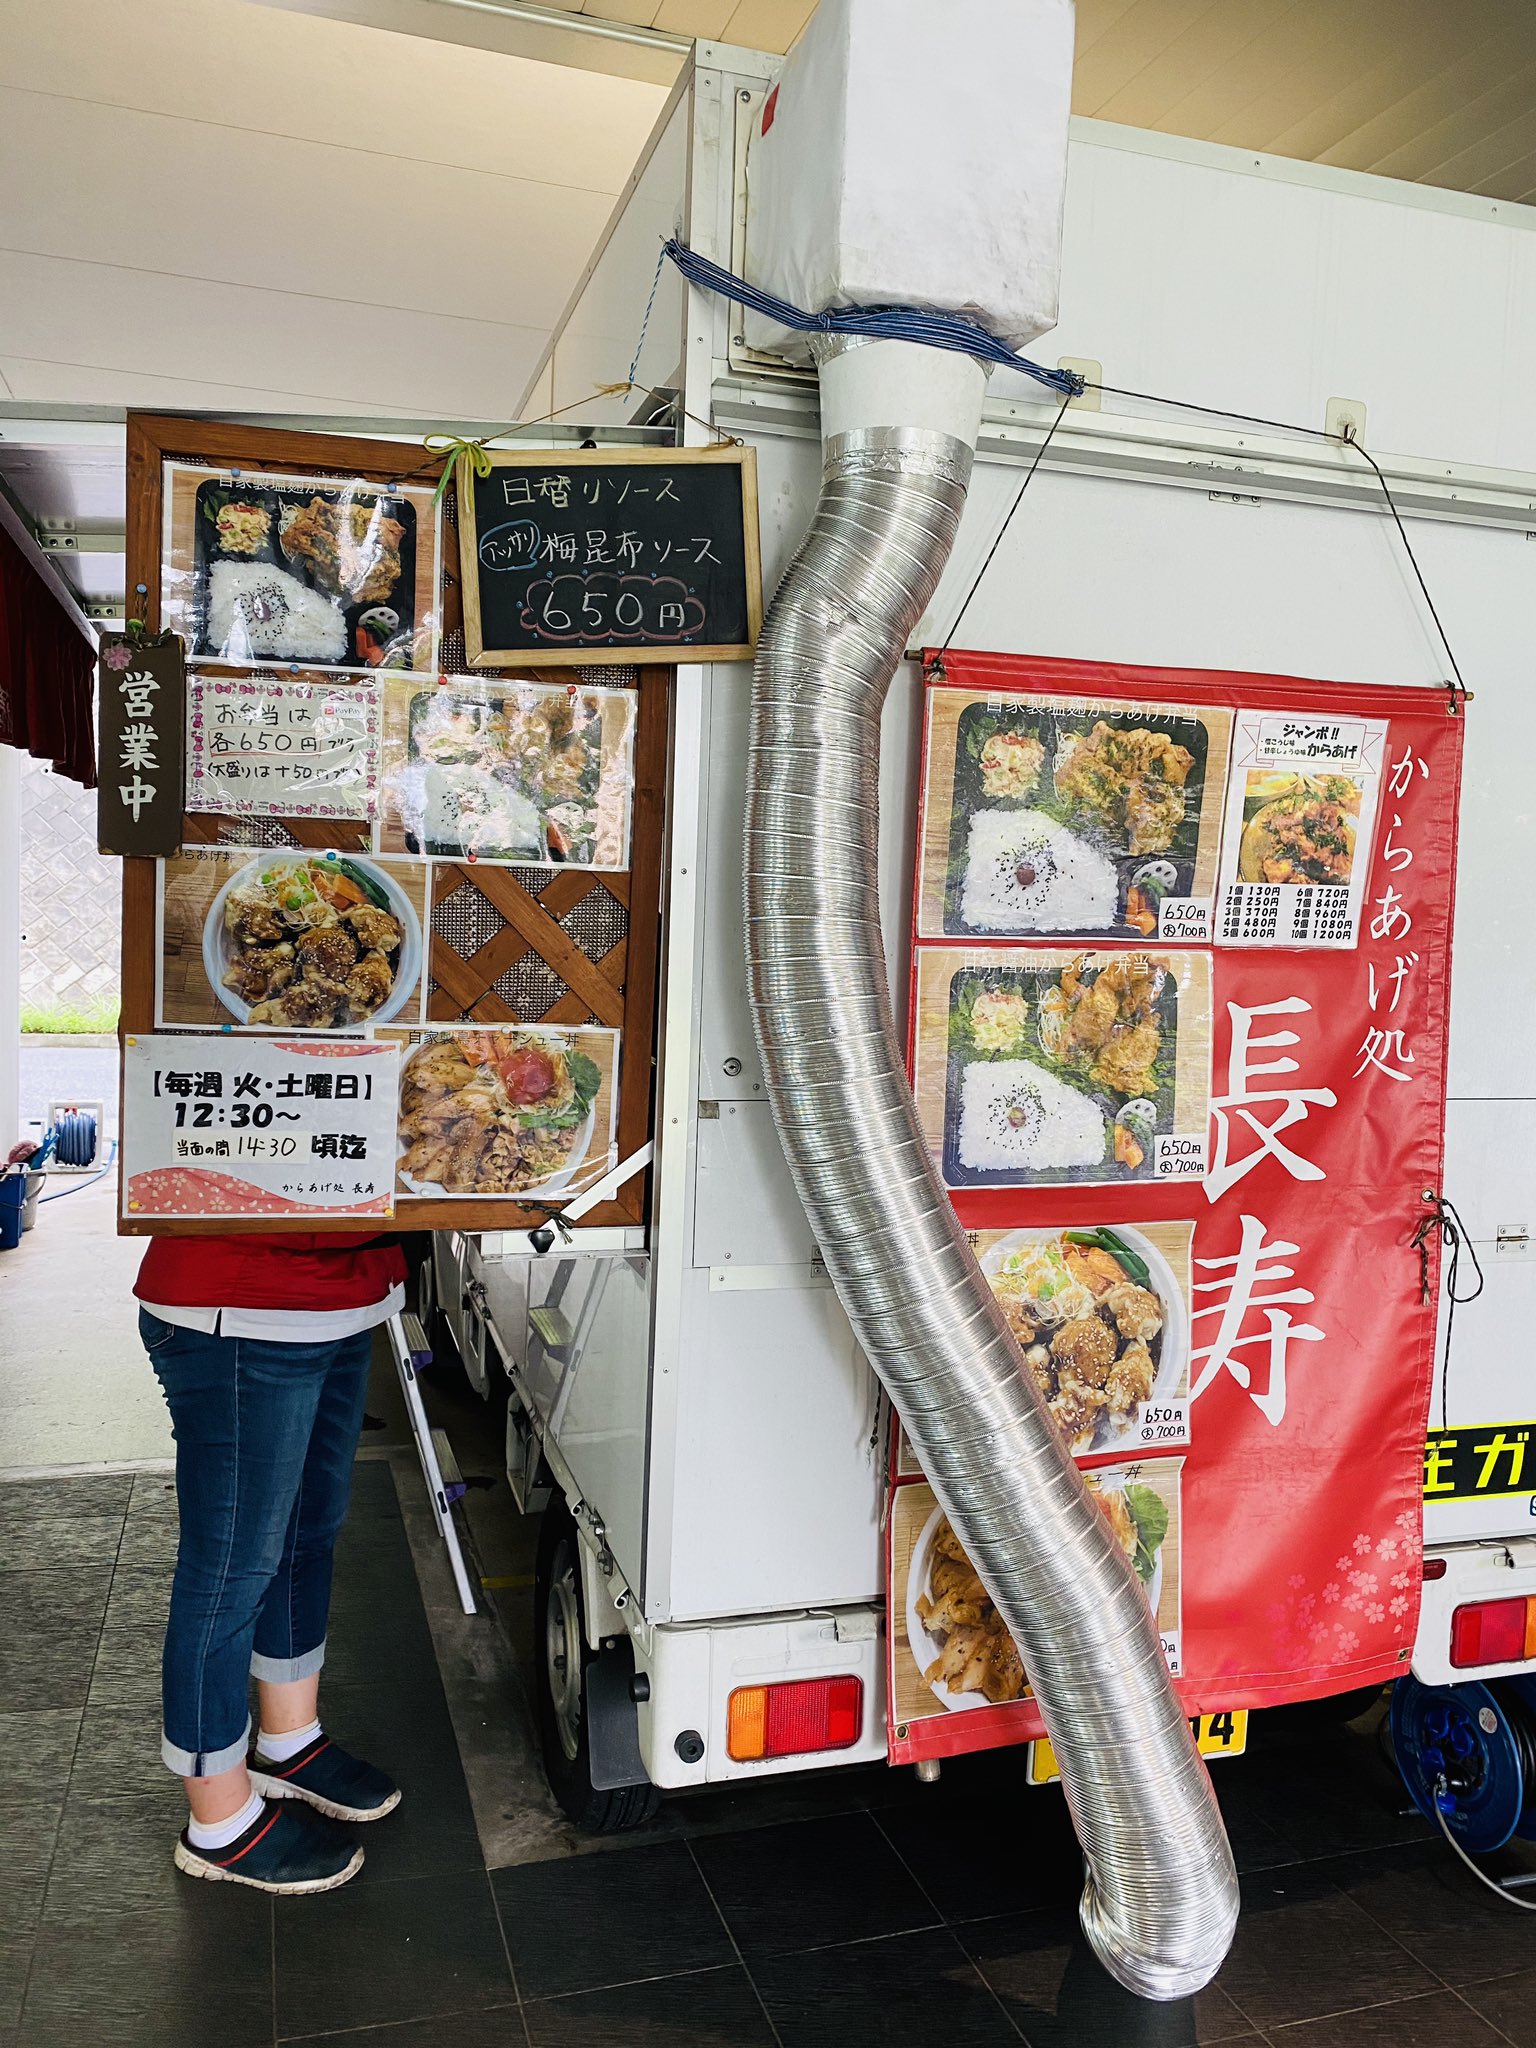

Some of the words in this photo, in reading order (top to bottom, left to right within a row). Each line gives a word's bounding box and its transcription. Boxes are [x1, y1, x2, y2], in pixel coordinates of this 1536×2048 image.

[540, 530, 722, 568] 梅昆布ソース
[543, 591, 685, 629] 650円
[118, 670, 161, 823] 営業中
[1307, 743, 1358, 759] からあげ
[179, 849, 234, 863] らあげ丼
[1249, 886, 1280, 896] 130円
[1317, 889, 1349, 898] 720円
[1246, 897, 1279, 906] 250円
[1316, 899, 1347, 908] 840円
[1164, 904, 1206, 919] 650円
[1245, 908, 1277, 917] 370円
[1314, 909, 1346, 919] 960円
[1353, 745, 1430, 1081] からあげ処
[1244, 918, 1276, 928] 480円
[1314, 920, 1352, 930] 1080円
[1243, 928, 1275, 938] 600円
[1312, 930, 1351, 940] 1200円
[311, 1134, 368, 1160] 頃迄
[1161, 1140, 1201, 1156] 650円
[352, 1182, 375, 1194] 長寿
[1190, 997, 1337, 1427] 長寿
[1145, 1407, 1182, 1423] 650円
